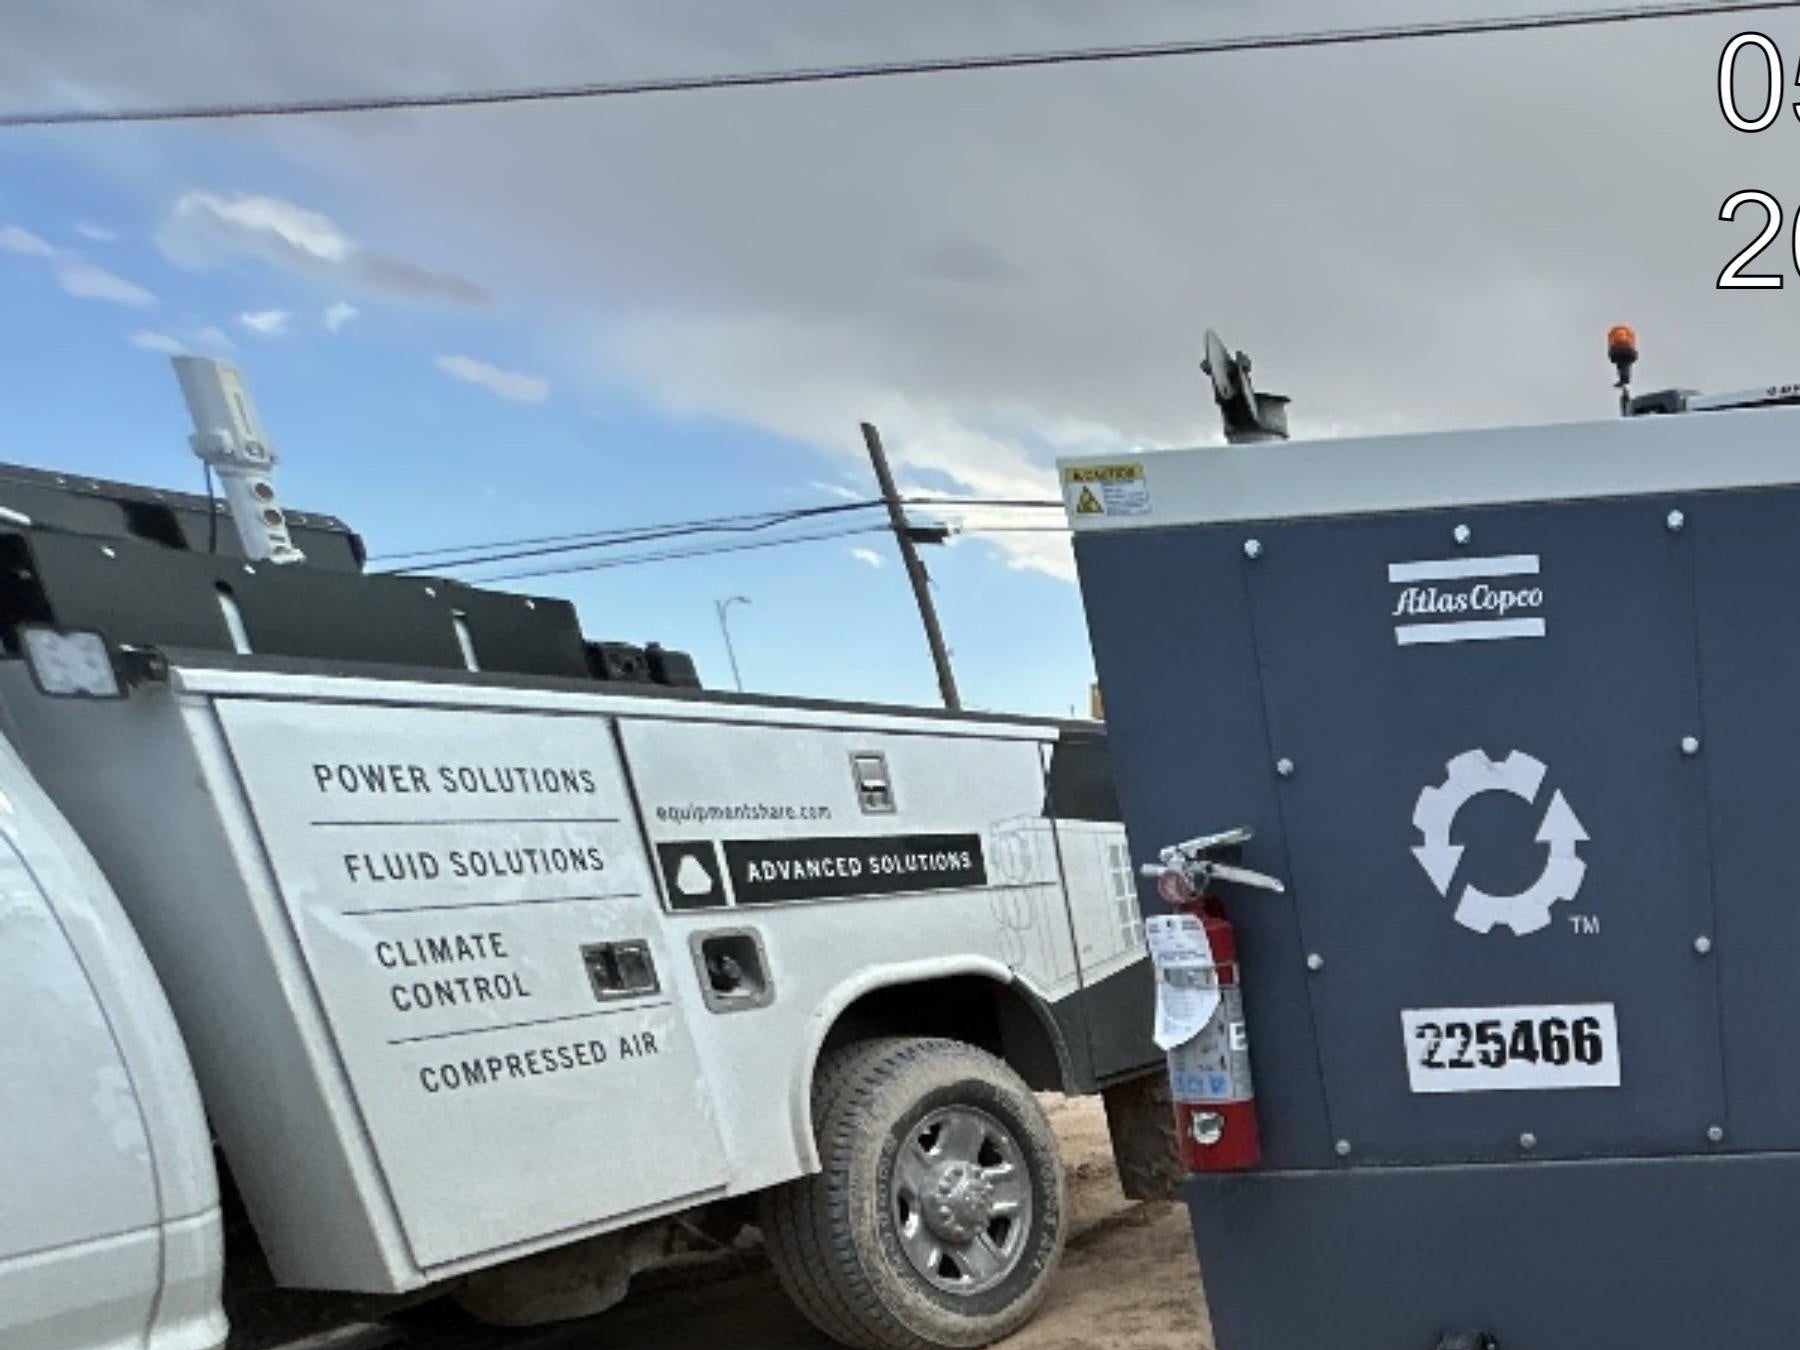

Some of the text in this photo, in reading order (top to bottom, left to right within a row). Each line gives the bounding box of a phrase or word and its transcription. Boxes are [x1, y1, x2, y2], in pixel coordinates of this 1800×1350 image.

[312, 764, 597, 794] POWER SOLUTIONS
[656, 802, 832, 824] equipmentshare.com
[344, 848, 605, 882] FLUID SOLUTIONS
[747, 850, 973, 883] ADVANCED SOLUTIONS
[1569, 915, 1600, 934] TM
[376, 932, 509, 968] CLIMATE
[390, 971, 532, 1012] CONTROL
[1415, 1016, 1603, 1069] 225466
[419, 1031, 659, 1093] COMPRESSED AIR
